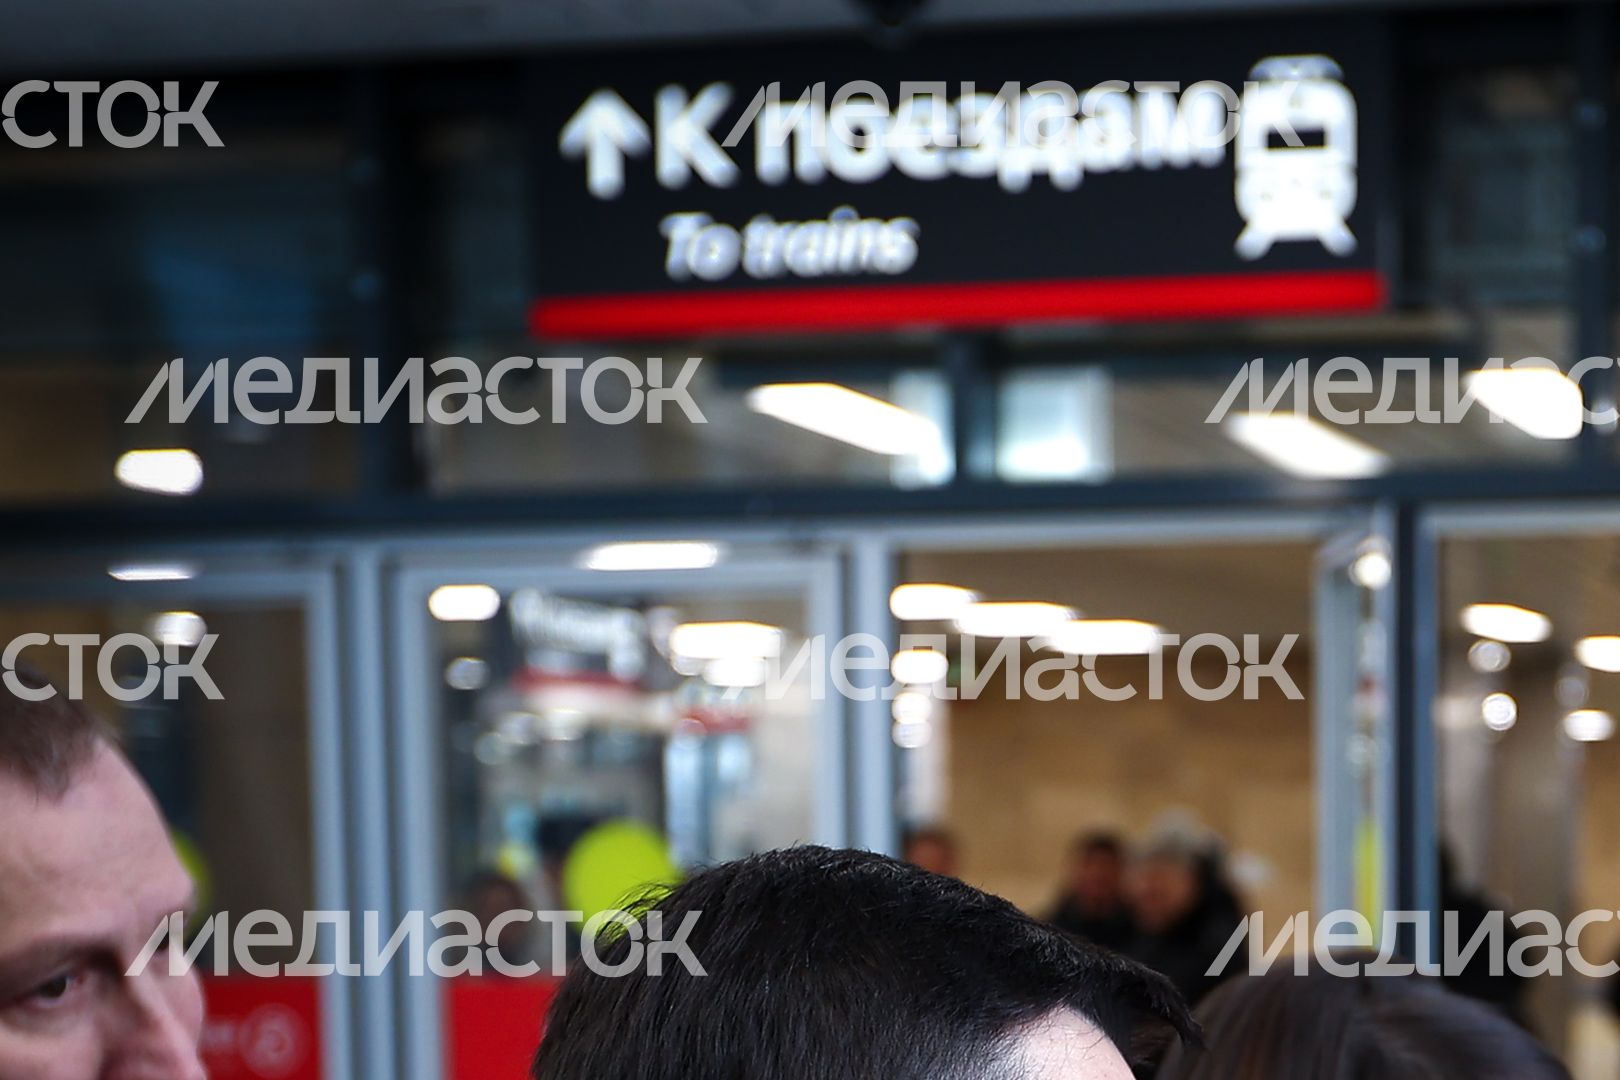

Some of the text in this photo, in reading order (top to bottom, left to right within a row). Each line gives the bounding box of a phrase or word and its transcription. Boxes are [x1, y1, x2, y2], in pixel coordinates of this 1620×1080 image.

[654, 82, 1227, 192] К поездам
[659, 205, 921, 282] To trains
